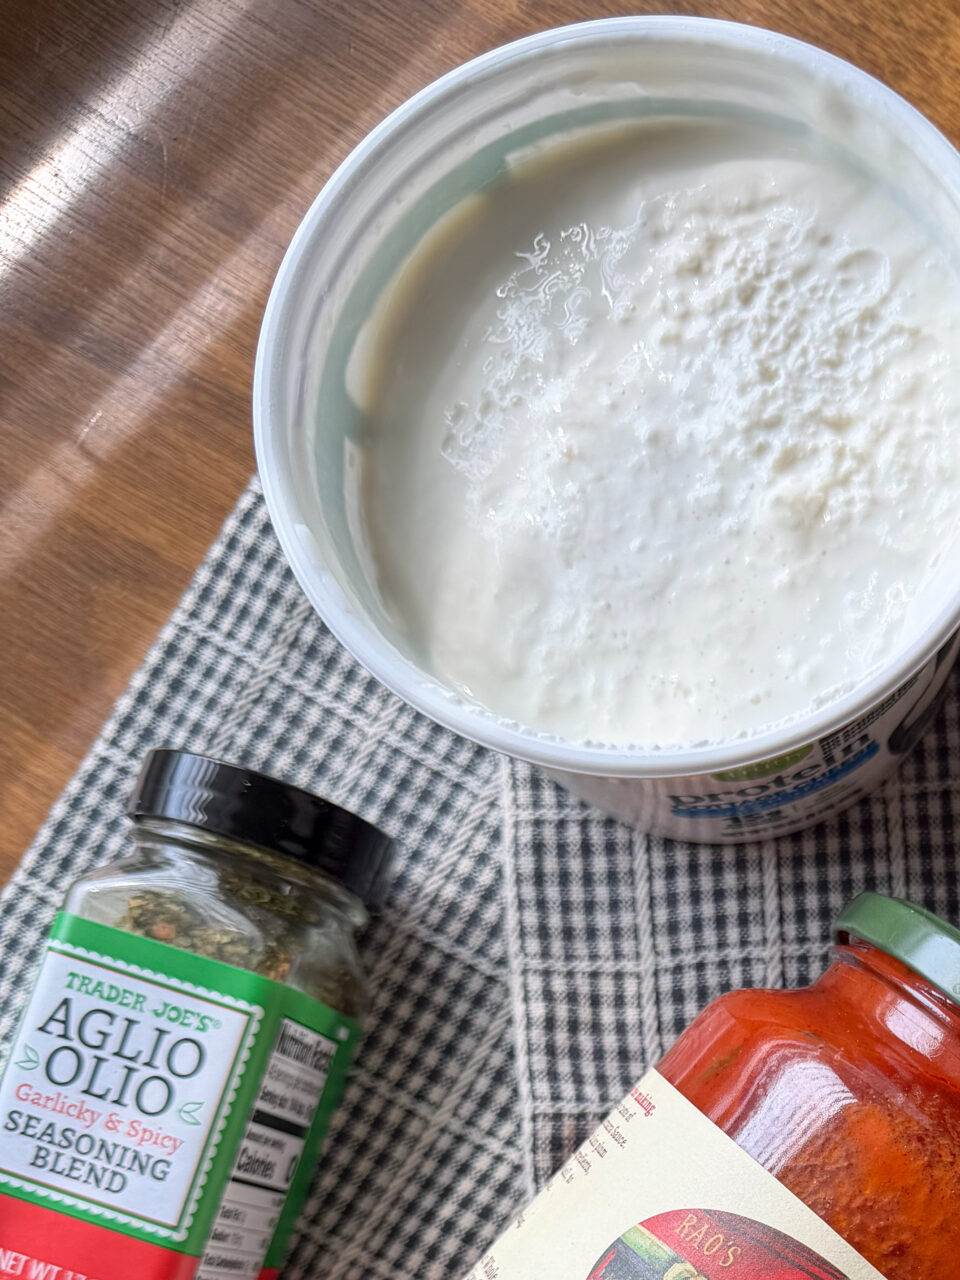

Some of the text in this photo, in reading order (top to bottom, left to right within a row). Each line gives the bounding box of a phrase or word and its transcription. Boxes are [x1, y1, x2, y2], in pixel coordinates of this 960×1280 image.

[66, 972, 147, 1012] TRADER
[37, 997, 206, 1080] AGLIO
[45, 1045, 174, 1117] OLIO
[4, 1109, 173, 1182] SEASONING
[15, 1083, 185, 1156] Garlicky & Spicy
[30, 1143, 128, 1194] BLEND
[237, 1146, 277, 1179] Calories
[0, 1247, 31, 1276] NET
[674, 1213, 741, 1267] RAO'S
